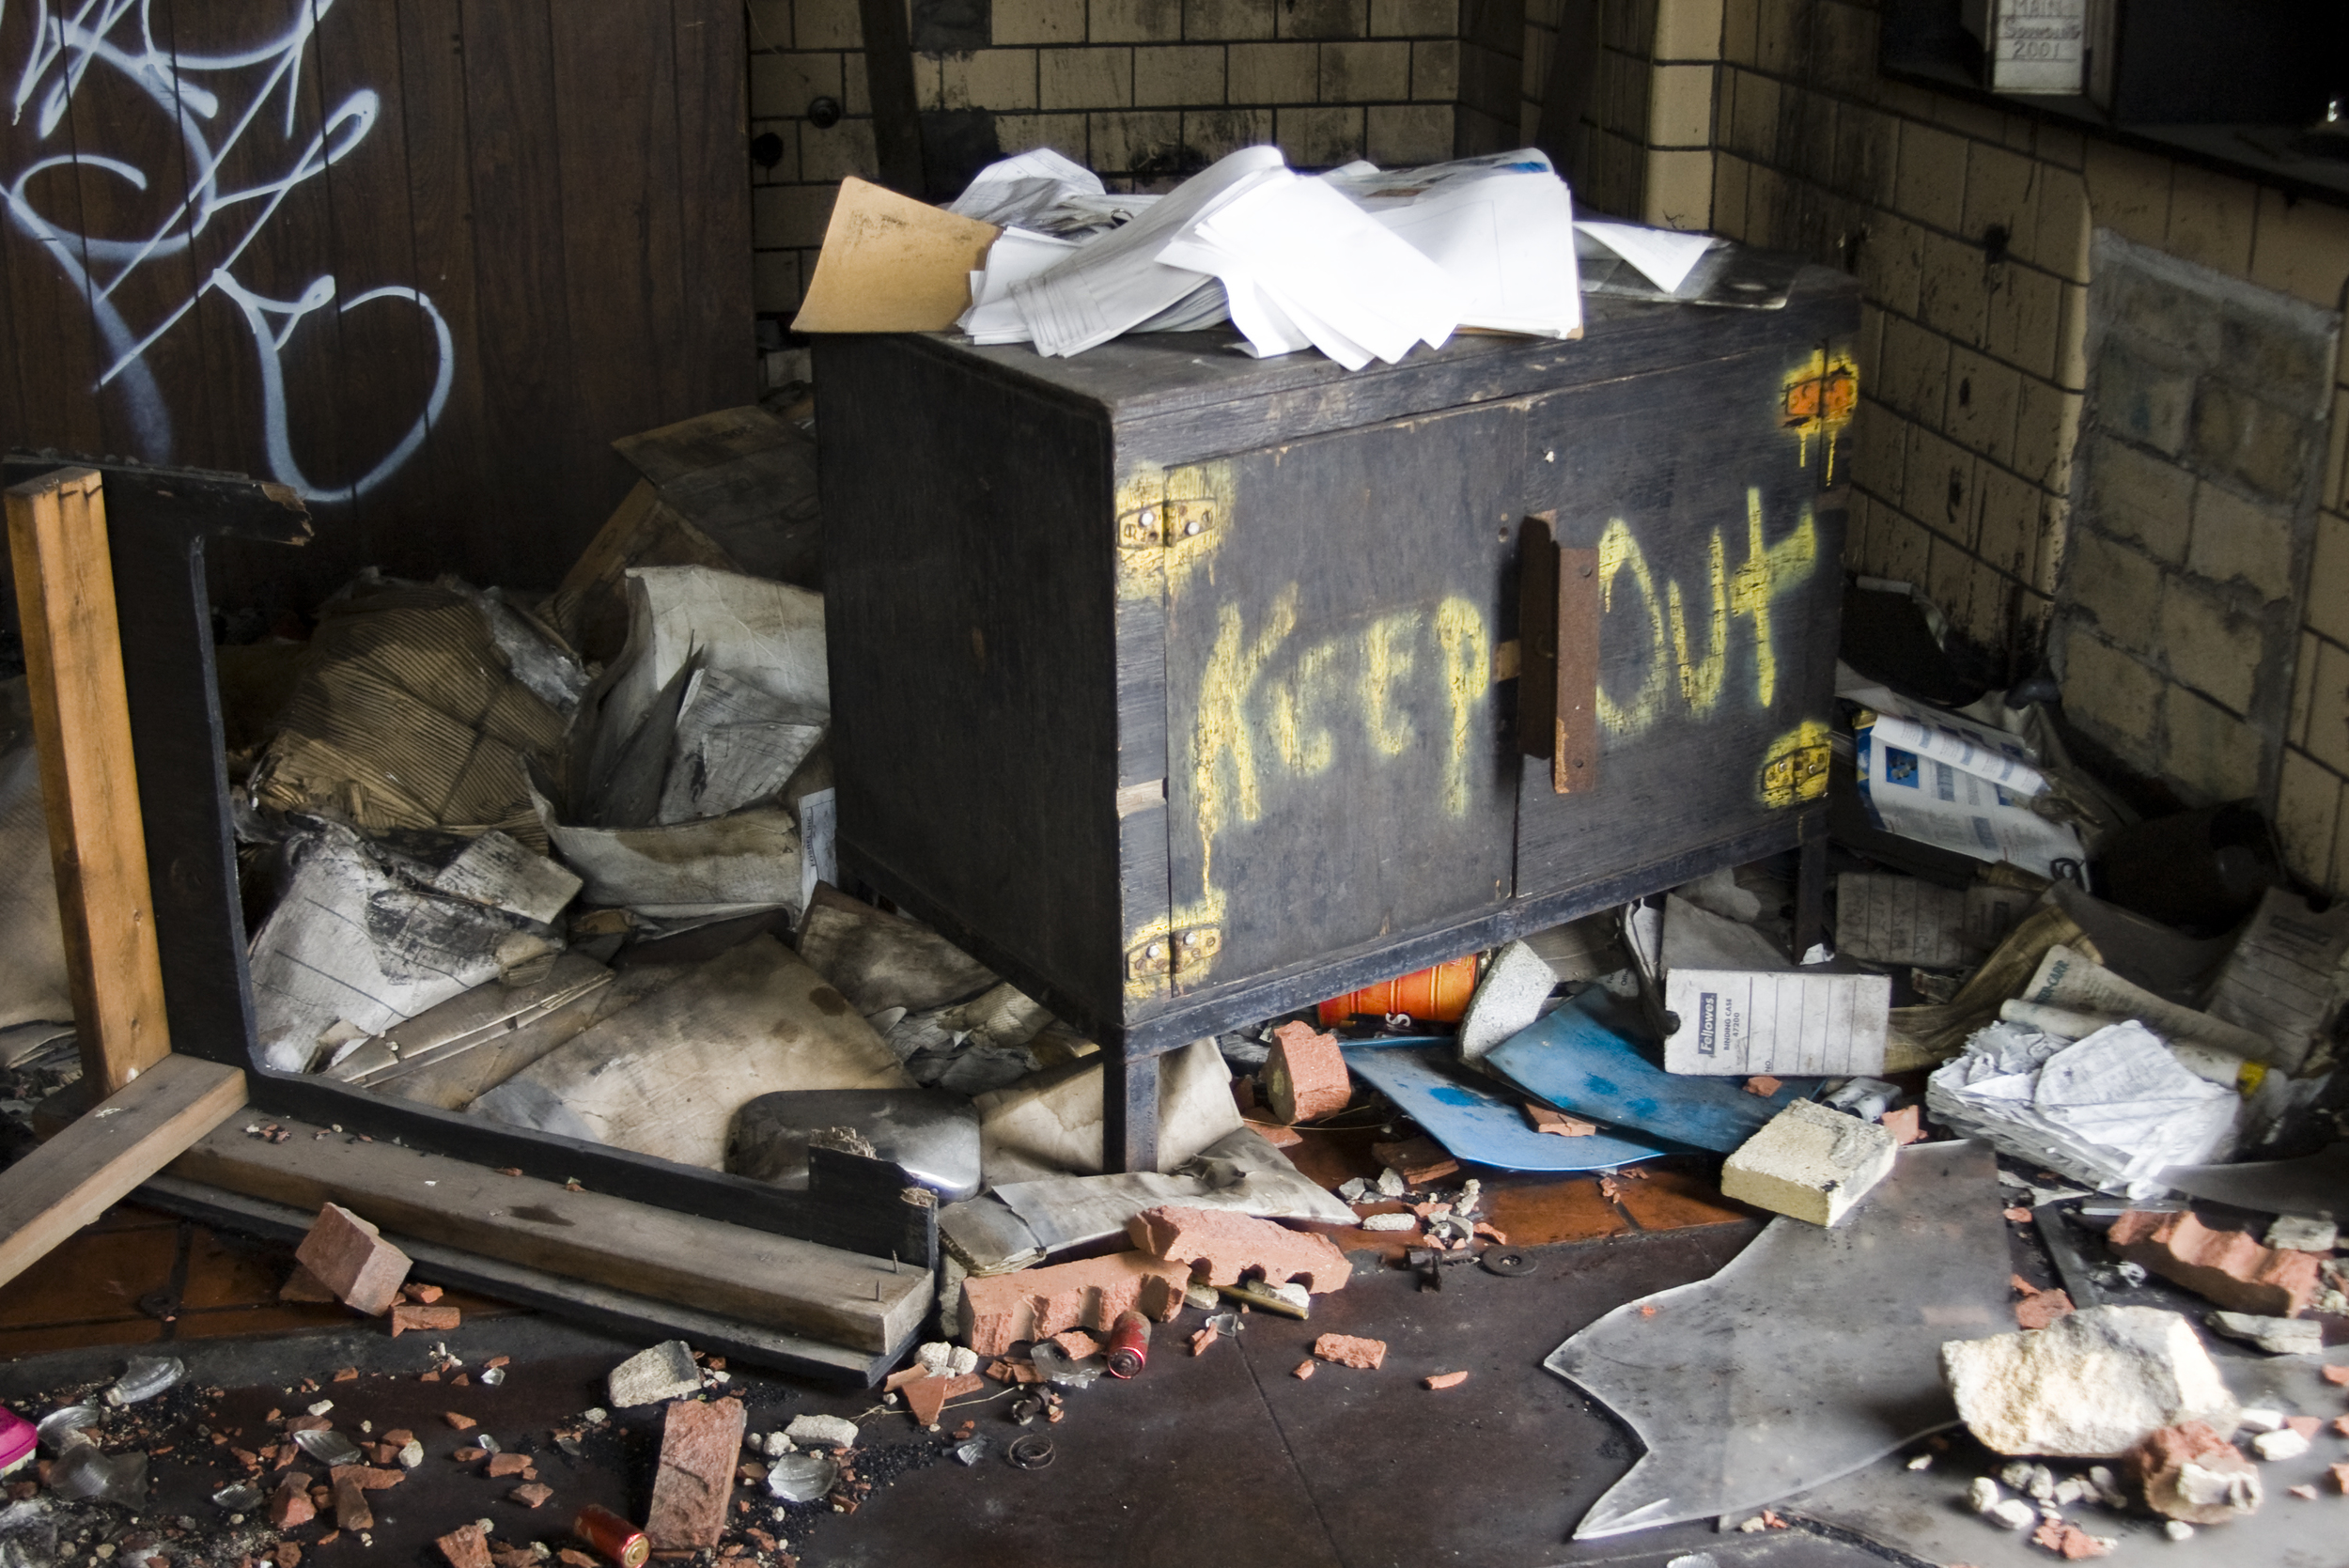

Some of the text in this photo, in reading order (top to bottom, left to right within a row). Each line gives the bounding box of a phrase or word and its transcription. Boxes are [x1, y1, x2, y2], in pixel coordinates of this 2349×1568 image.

[2012, 40, 2060, 59] 2001
[1191, 582, 1490, 836] KEEP
[1701, 996, 1716, 1051] Fellowes
